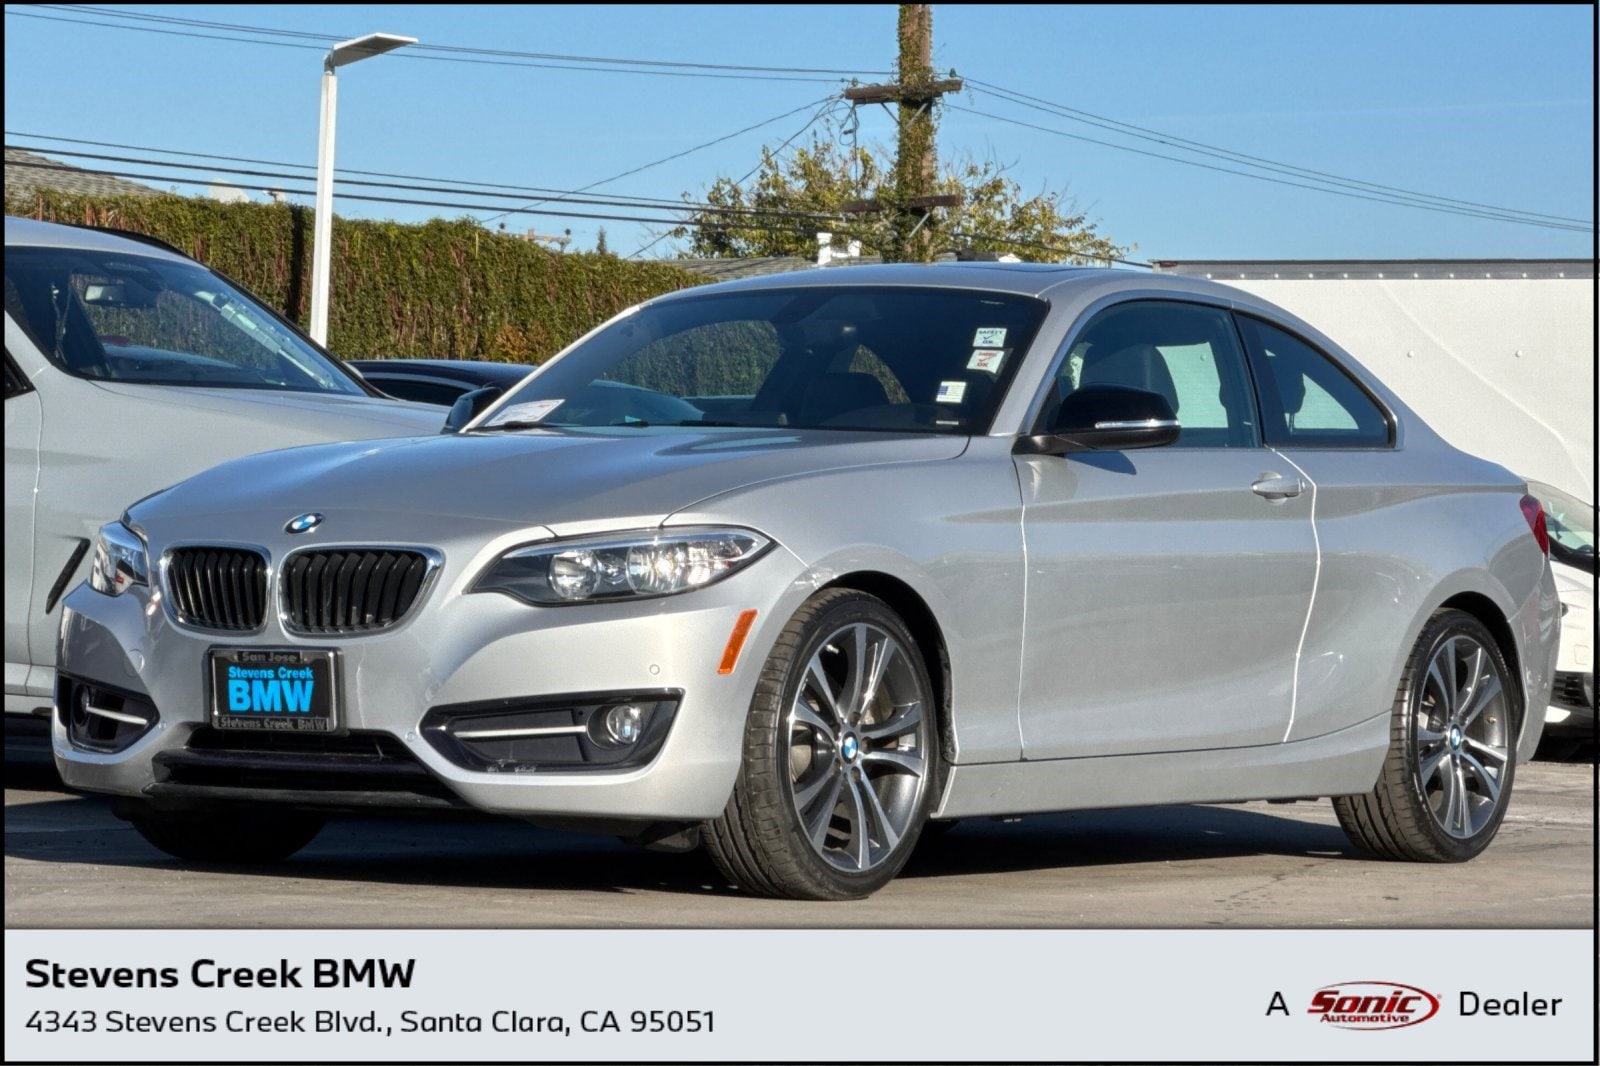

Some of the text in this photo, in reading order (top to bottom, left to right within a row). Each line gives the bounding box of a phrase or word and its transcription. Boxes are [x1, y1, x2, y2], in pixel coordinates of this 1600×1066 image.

[242, 652, 298, 663] San Jose
[228, 666, 315, 679] Stevens Creek
[228, 679, 315, 713] BMW
[220, 717, 326, 731] Stevens Creek BMW
